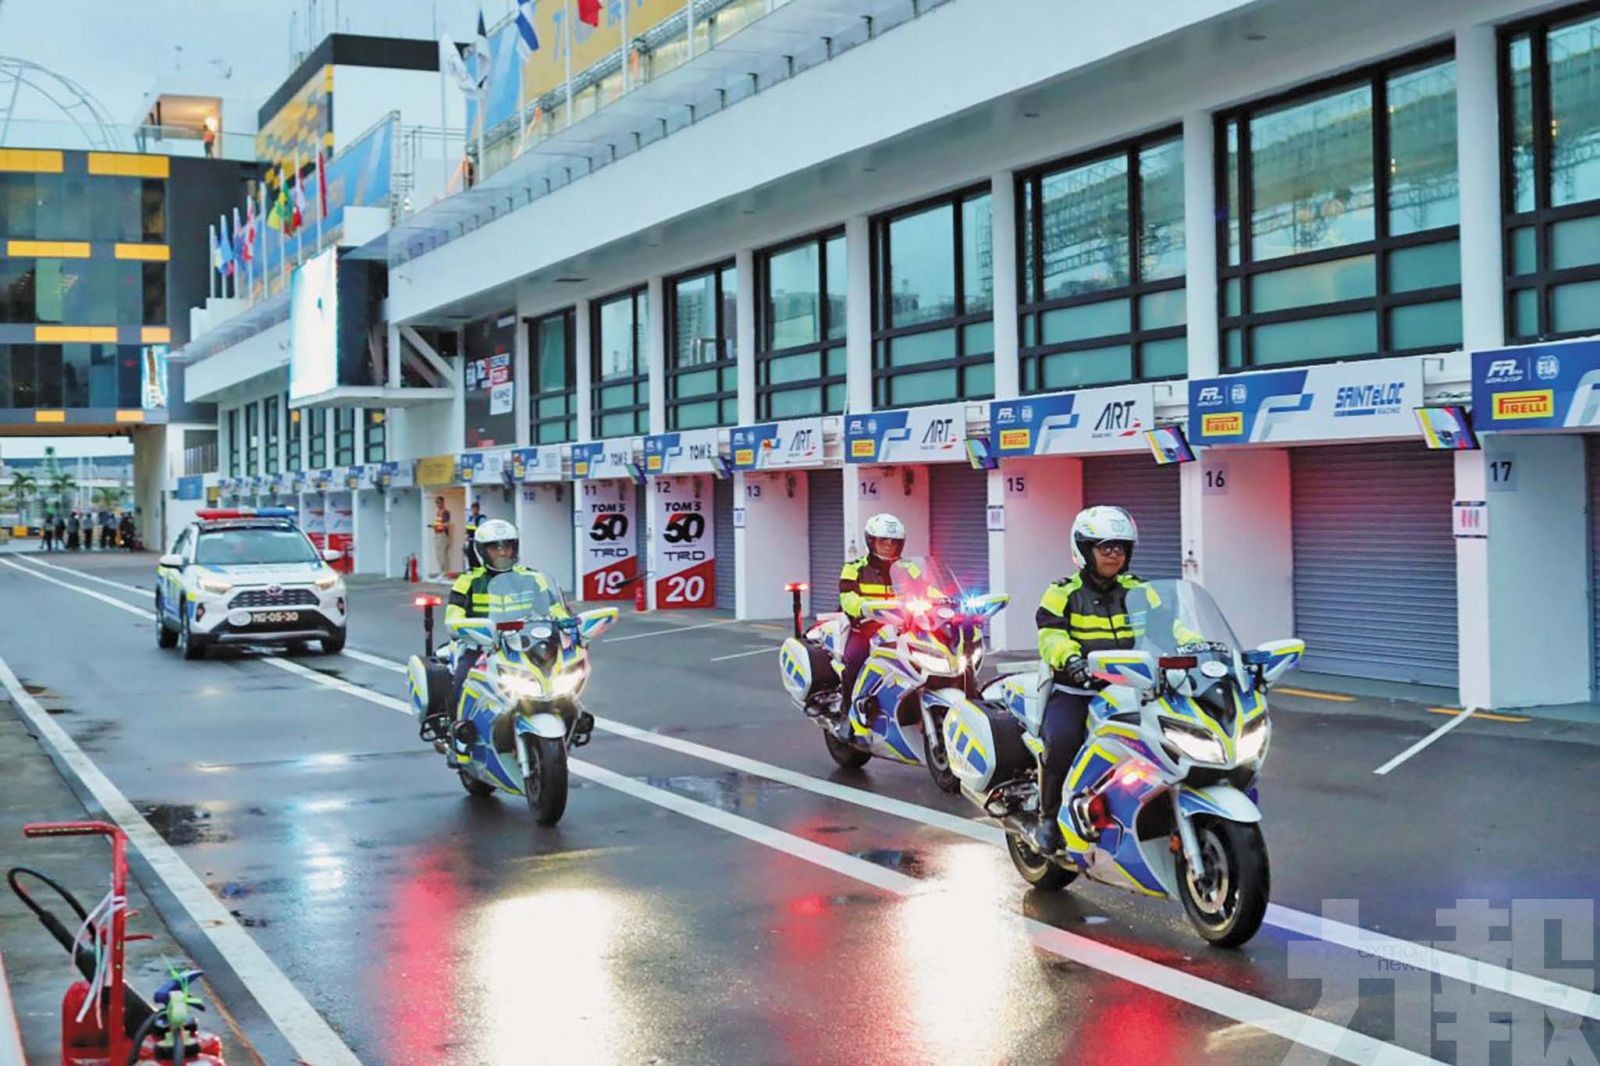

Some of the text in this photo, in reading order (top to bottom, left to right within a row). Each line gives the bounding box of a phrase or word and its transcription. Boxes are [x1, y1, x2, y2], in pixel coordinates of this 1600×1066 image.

[1498, 395, 1548, 415] PIRELLI
[1094, 400, 1136, 431] ART
[1206, 416, 1240, 432] PIRELLI
[922, 418, 954, 444] ART
[1205, 470, 1226, 488] 16
[1490, 461, 1513, 482] 17
[584, 485, 597, 496] 11
[656, 481, 671, 493] 12
[747, 485, 761, 497] 13
[861, 482, 877, 495] 14
[1007, 477, 1025, 492] 15
[589, 513, 628, 541] 50
[663, 512, 705, 543] 50
[589, 548, 629, 558] TRD
[663, 551, 705, 561] TRD
[593, 570, 625, 595] 19
[665, 575, 705, 602] 20
